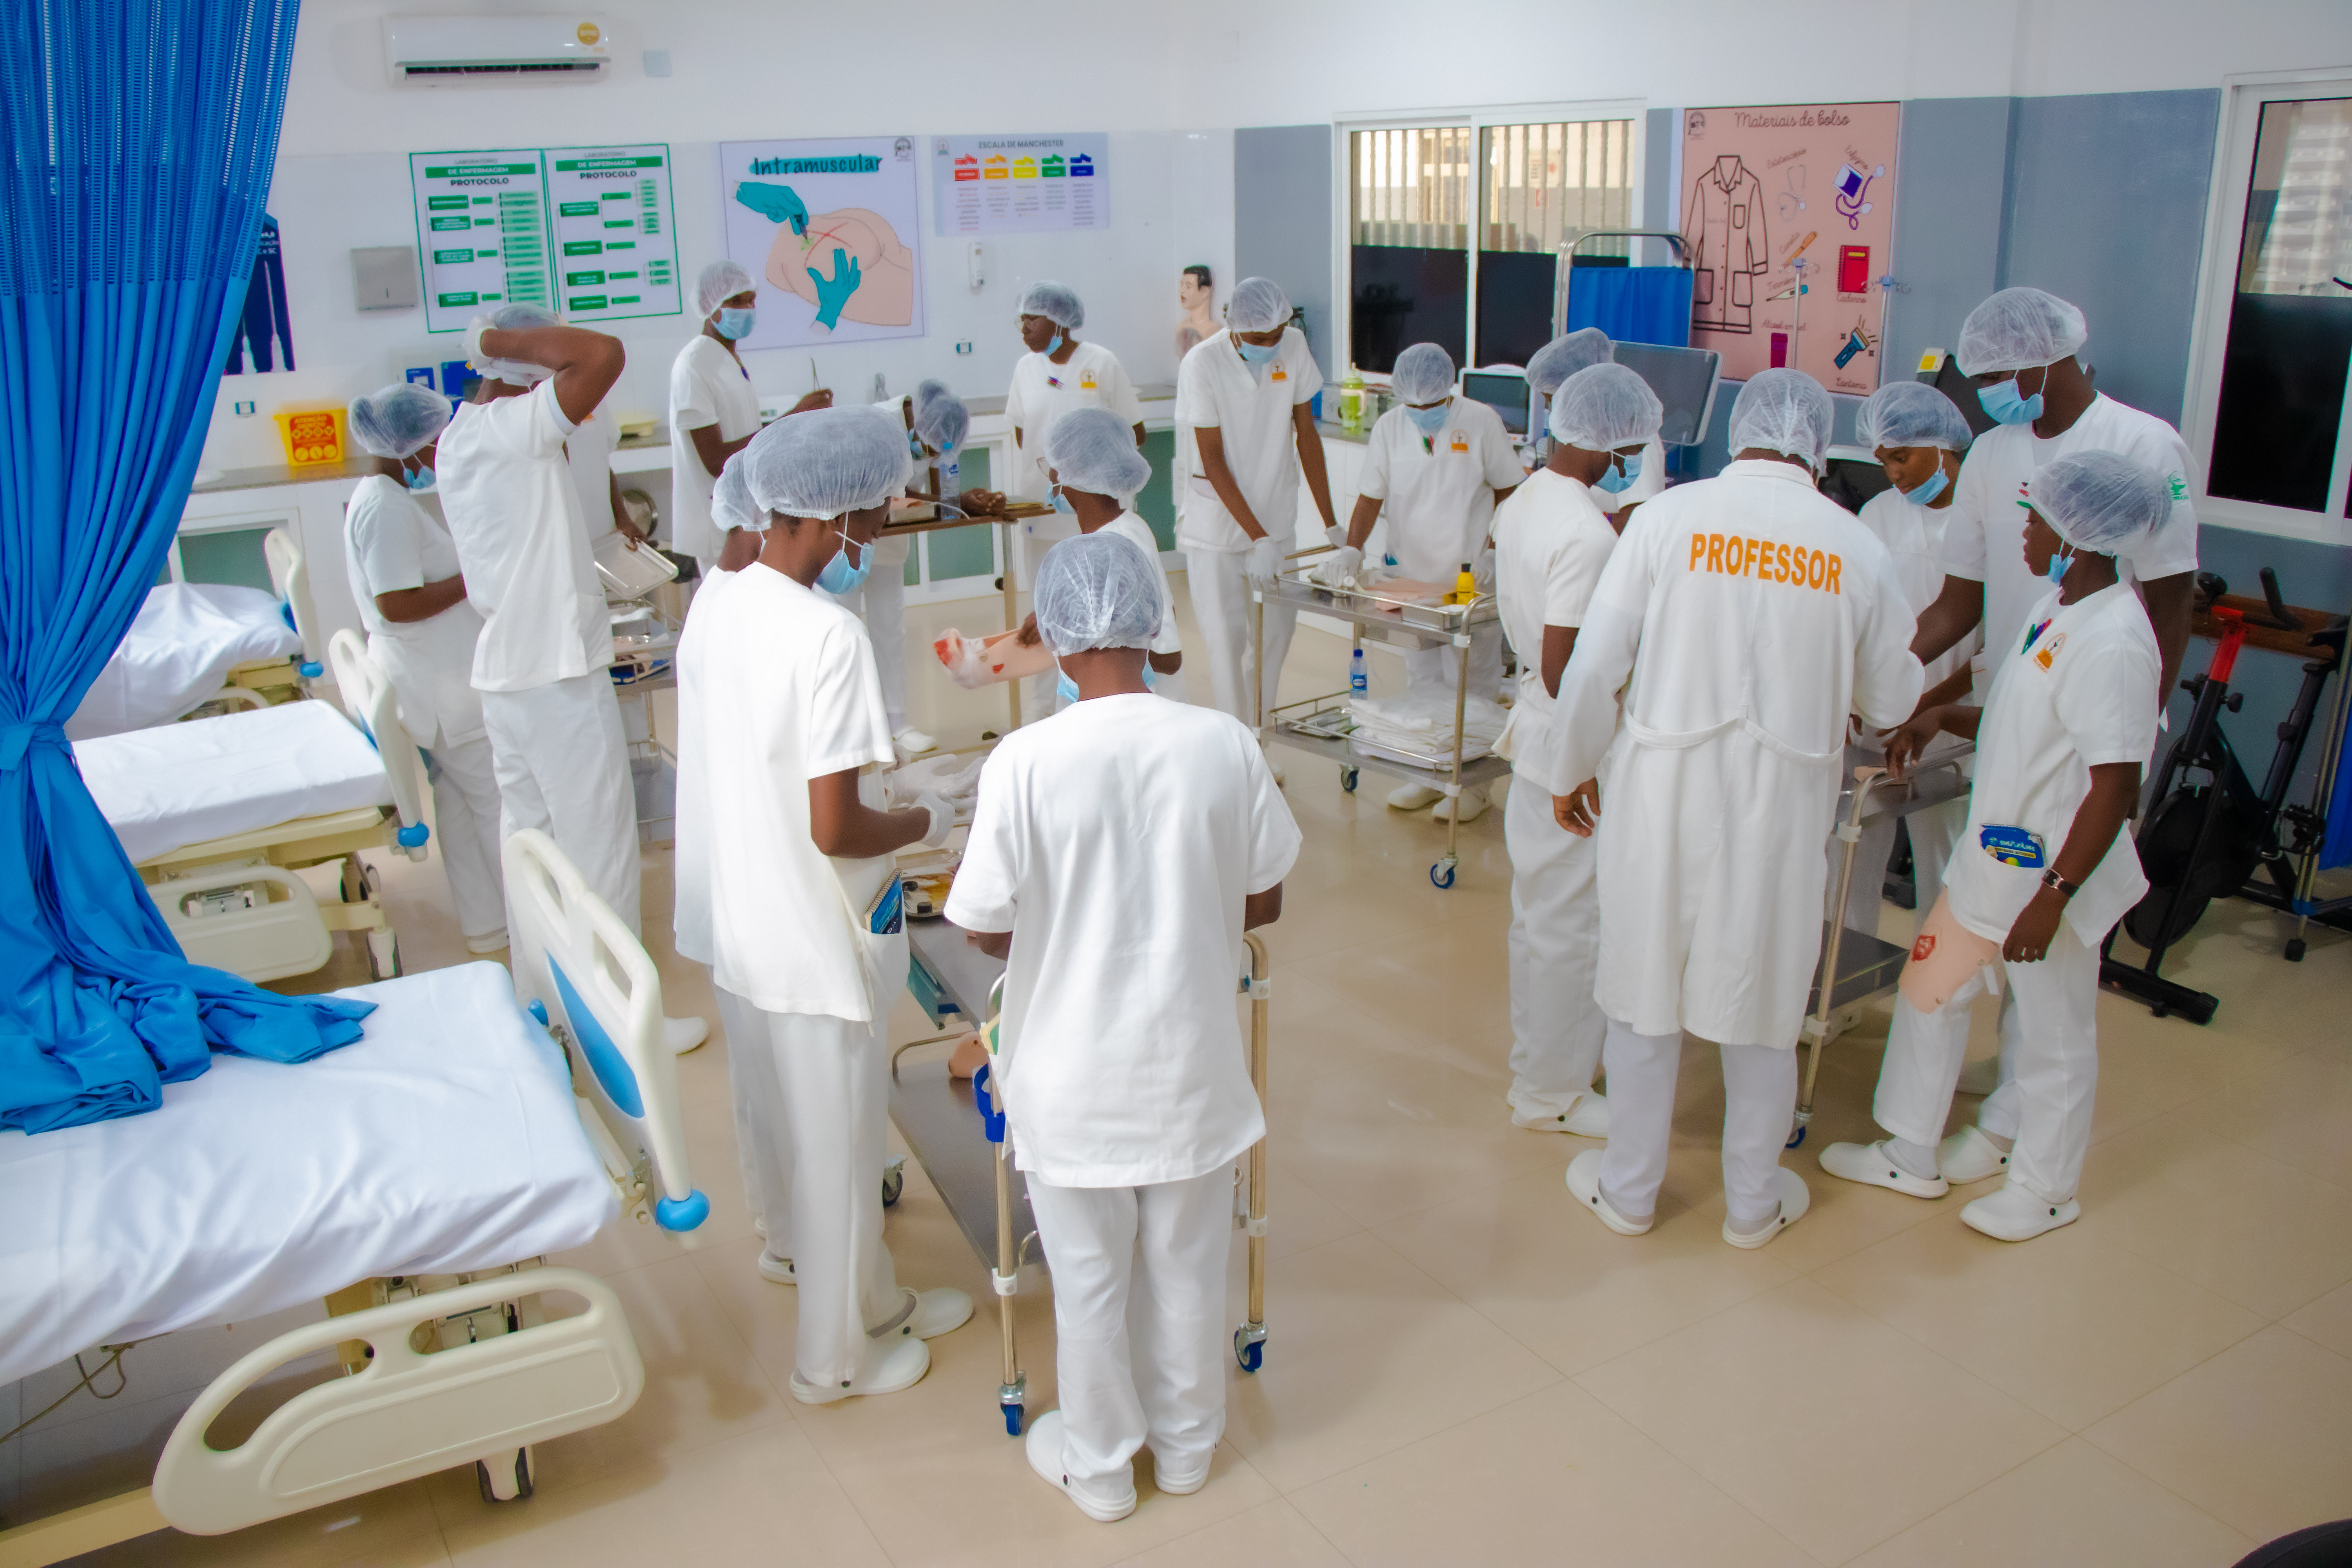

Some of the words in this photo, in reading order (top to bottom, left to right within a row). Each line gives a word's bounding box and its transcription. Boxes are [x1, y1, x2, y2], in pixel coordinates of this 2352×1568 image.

[1735, 112, 1797, 127] Materiais
[1799, 110, 1815, 126] de
[1818, 109, 1850, 126] bolso
[1017, 139, 1063, 147] MANCHESTER
[754, 153, 883, 175] Intramuscular
[580, 170, 637, 179] PROTOCOLO
[451, 177, 509, 186] PROTOCOLO
[1837, 292, 1867, 303] Caderno
[1837, 377, 1867, 389] Lanterna
[1689, 533, 1841, 595] PROFESSOR
